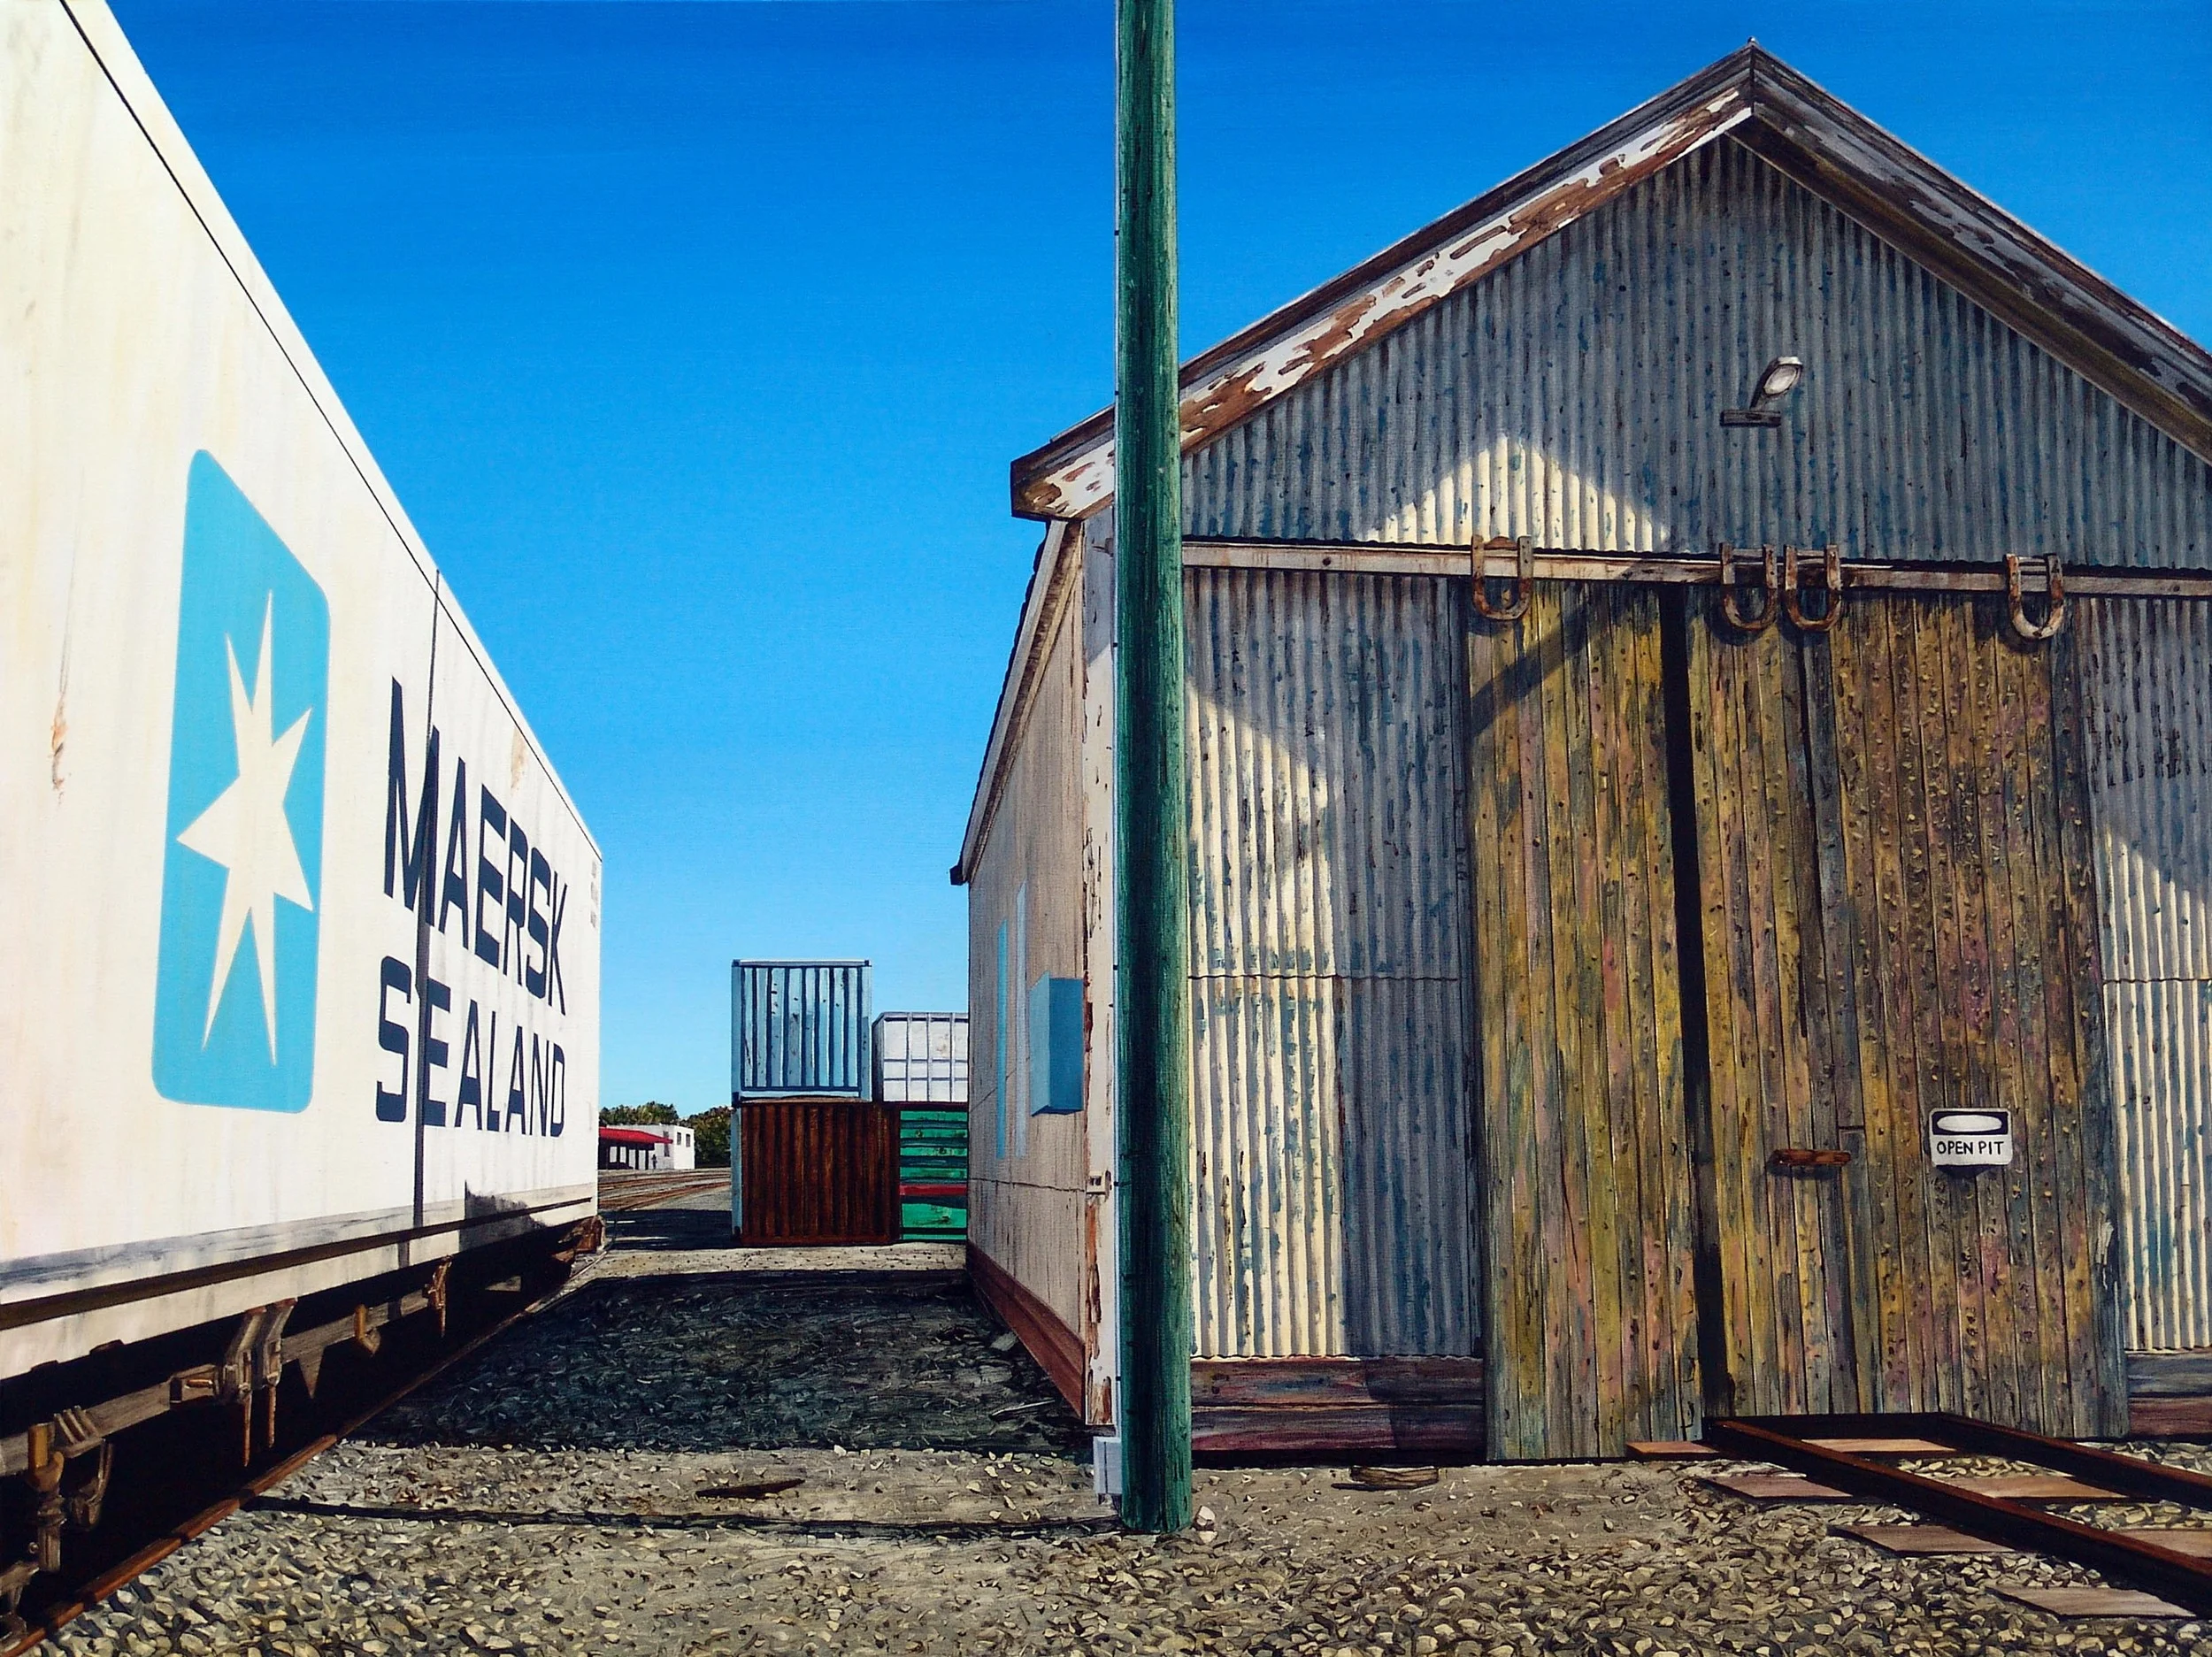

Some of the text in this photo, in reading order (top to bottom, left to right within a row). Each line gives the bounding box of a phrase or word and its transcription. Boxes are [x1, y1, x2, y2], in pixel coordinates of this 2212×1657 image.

[384, 675, 567, 1016] MAERSK
[376, 955, 565, 1138] SEALAND
[1937, 1140, 2004, 1155] OPEN PIT
